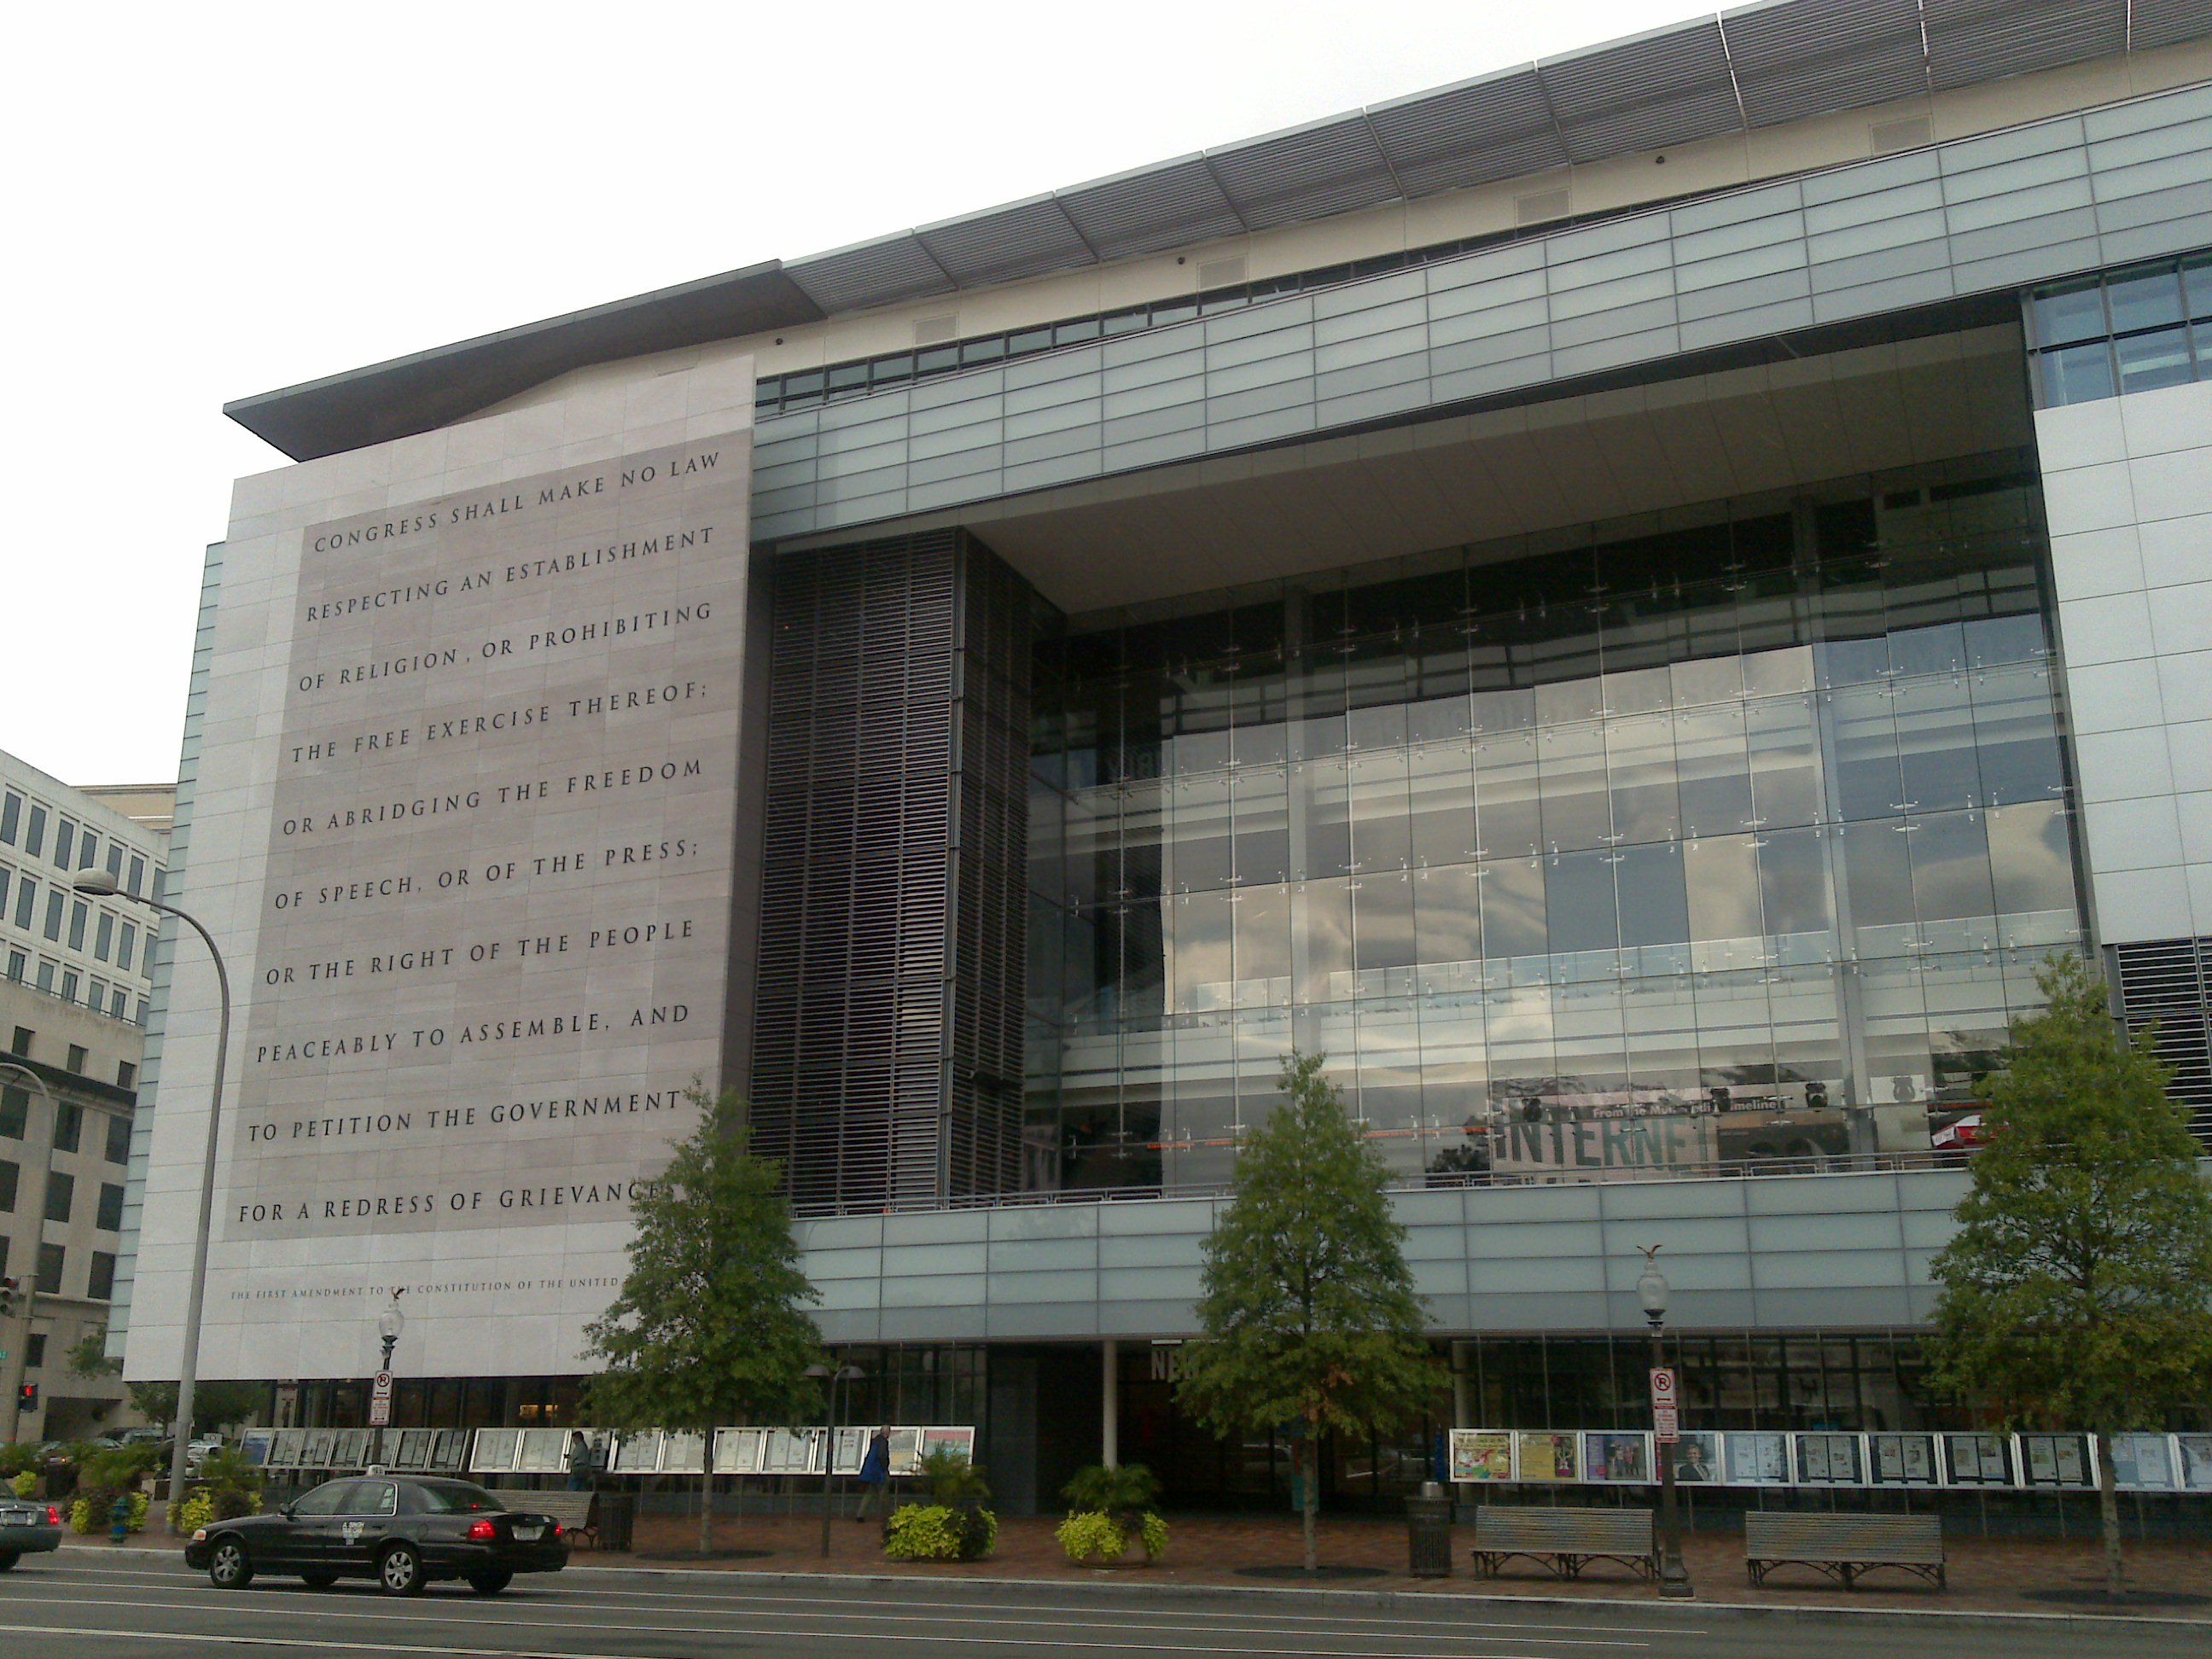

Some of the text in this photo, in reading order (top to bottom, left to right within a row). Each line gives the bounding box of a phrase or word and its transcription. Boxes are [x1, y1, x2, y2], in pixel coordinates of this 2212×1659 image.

[315, 452, 719, 553] CONGRESS SHALL MAKE NO LAW
[307, 527, 714, 622] RESPECTING AN ESTABLISHMENT
[300, 603, 712, 691] OF RELIGION, OR PROHIBITING
[293, 683, 707, 763] THE FREE EXERCISE THEREOF;
[283, 760, 701, 835] OR ABRIDGING THE FREEDOM
[276, 839, 696, 910] OF SPEECH, OR OF THE PRESS;
[266, 920, 693, 986] OR THE RIGHT OF THE PEOPLE
[258, 1004, 689, 1063] PEACEABLY TO ASSEMBLE, AND
[249, 1091, 679, 1142] TO PETITION THE GOVERNMENT
[1593, 1108, 1624, 1118] From
[1724, 1098, 1777, 1111] imeline
[239, 1203, 282, 1223] FOR
[298, 1202, 309, 1220] A
[325, 1196, 434, 1218] REDRESS
[451, 1192, 482, 1210] OF
[230, 1290, 250, 1299] THE
[257, 1289, 286, 1299] FIRST
[292, 1286, 363, 1298] AMENDMENT
[370, 1286, 386, 1295] TO
[417, 1282, 511, 1293] CONSTITUTION
[518, 1281, 532, 1289] OF
[539, 1279, 563, 1289] THE
[569, 1278, 618, 1287] UNITED
